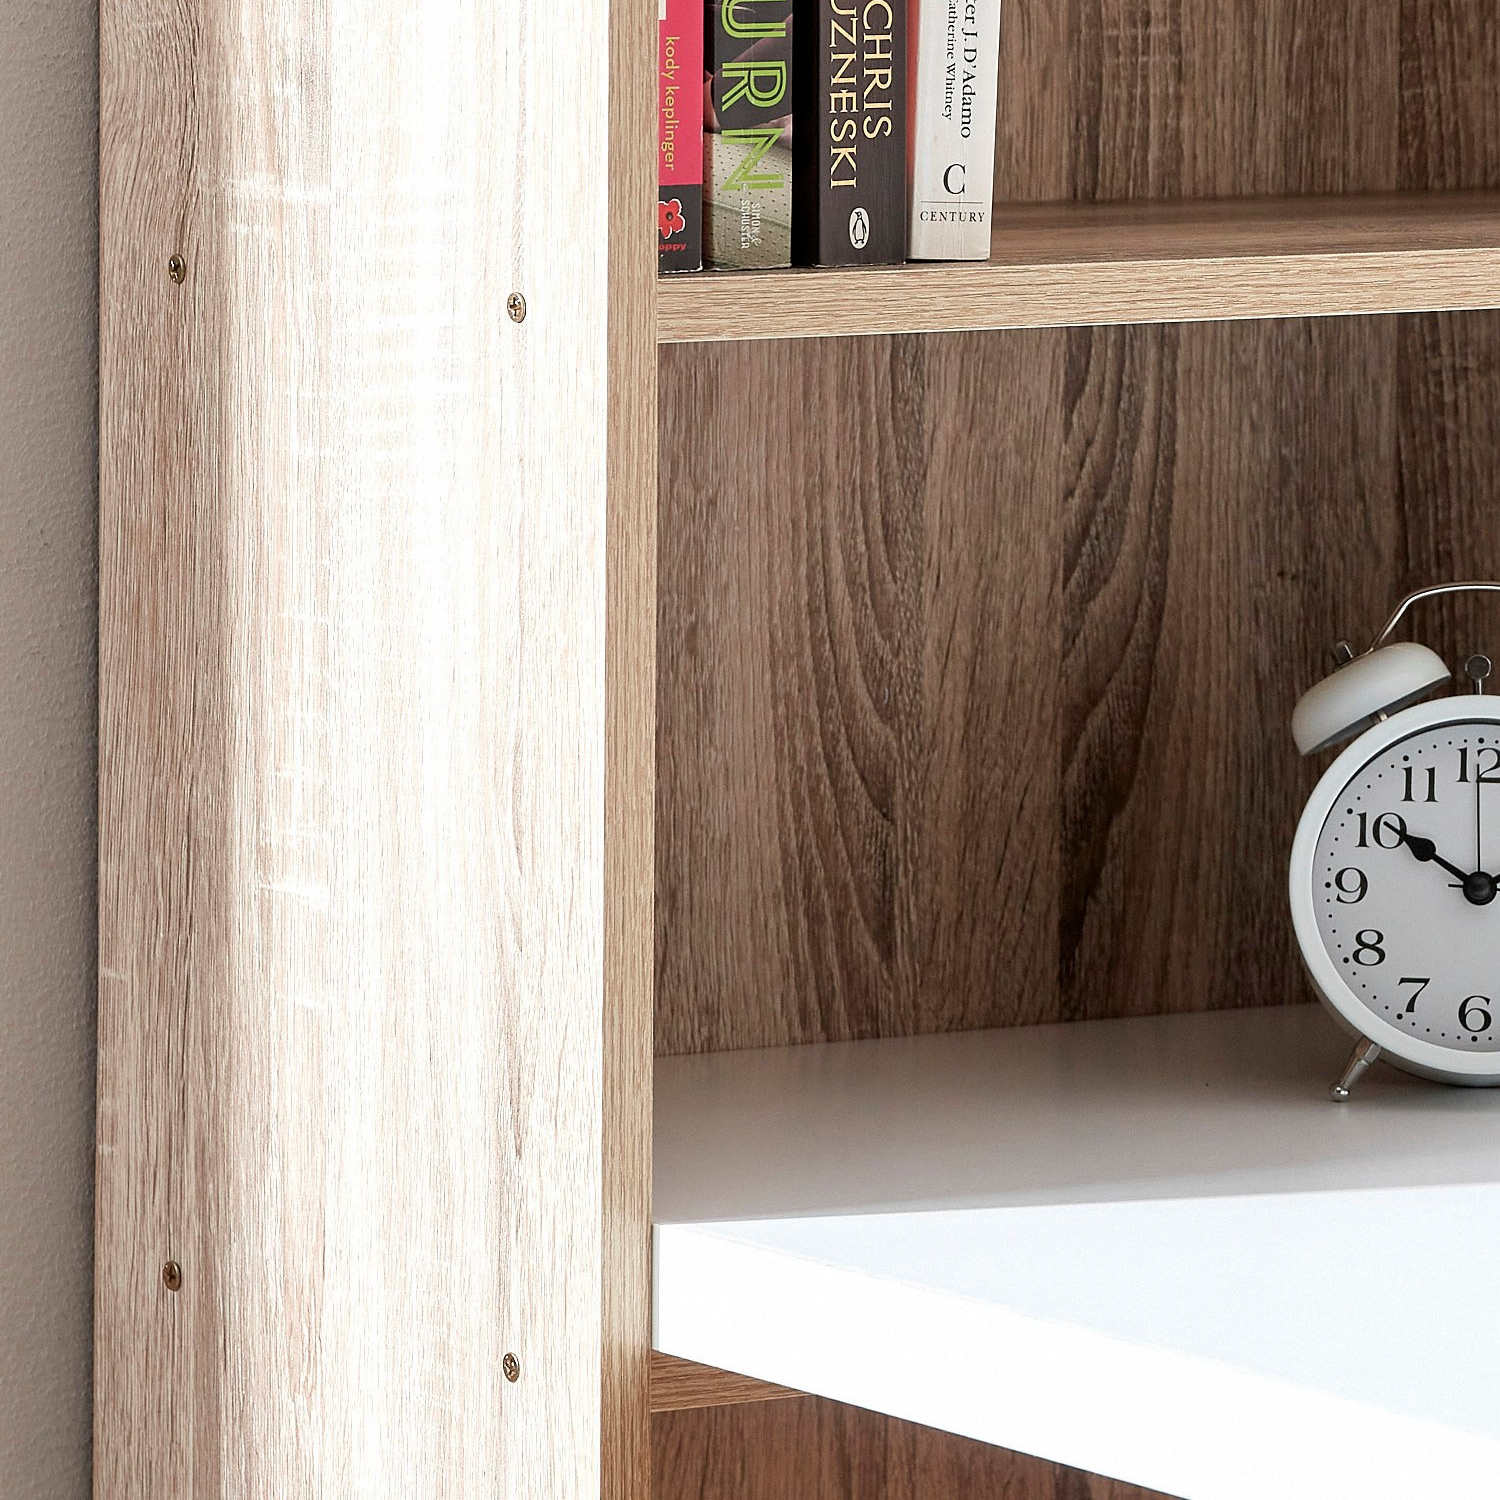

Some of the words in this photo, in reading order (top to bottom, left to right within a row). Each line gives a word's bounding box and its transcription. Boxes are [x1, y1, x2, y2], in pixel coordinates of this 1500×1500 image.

[961, 27, 978, 42] J.
[661, 36, 680, 79] kody
[941, 62, 956, 121] Whitney
[662, 85, 680, 171] keplinger
[942, 163, 967, 195] C
[740, 199, 750, 249] SCHUSTER
[752, 203, 761, 233] SIMON
[919, 210, 986, 223] CENTURY
[658, 243, 687, 252] oppy
[1401, 766, 1439, 803] 11
[1355, 811, 1408, 850] 10
[1334, 867, 1369, 904] 9
[1351, 928, 1386, 967] 8
[1397, 976, 1431, 1013] 7
[1457, 995, 1492, 1033] 6
